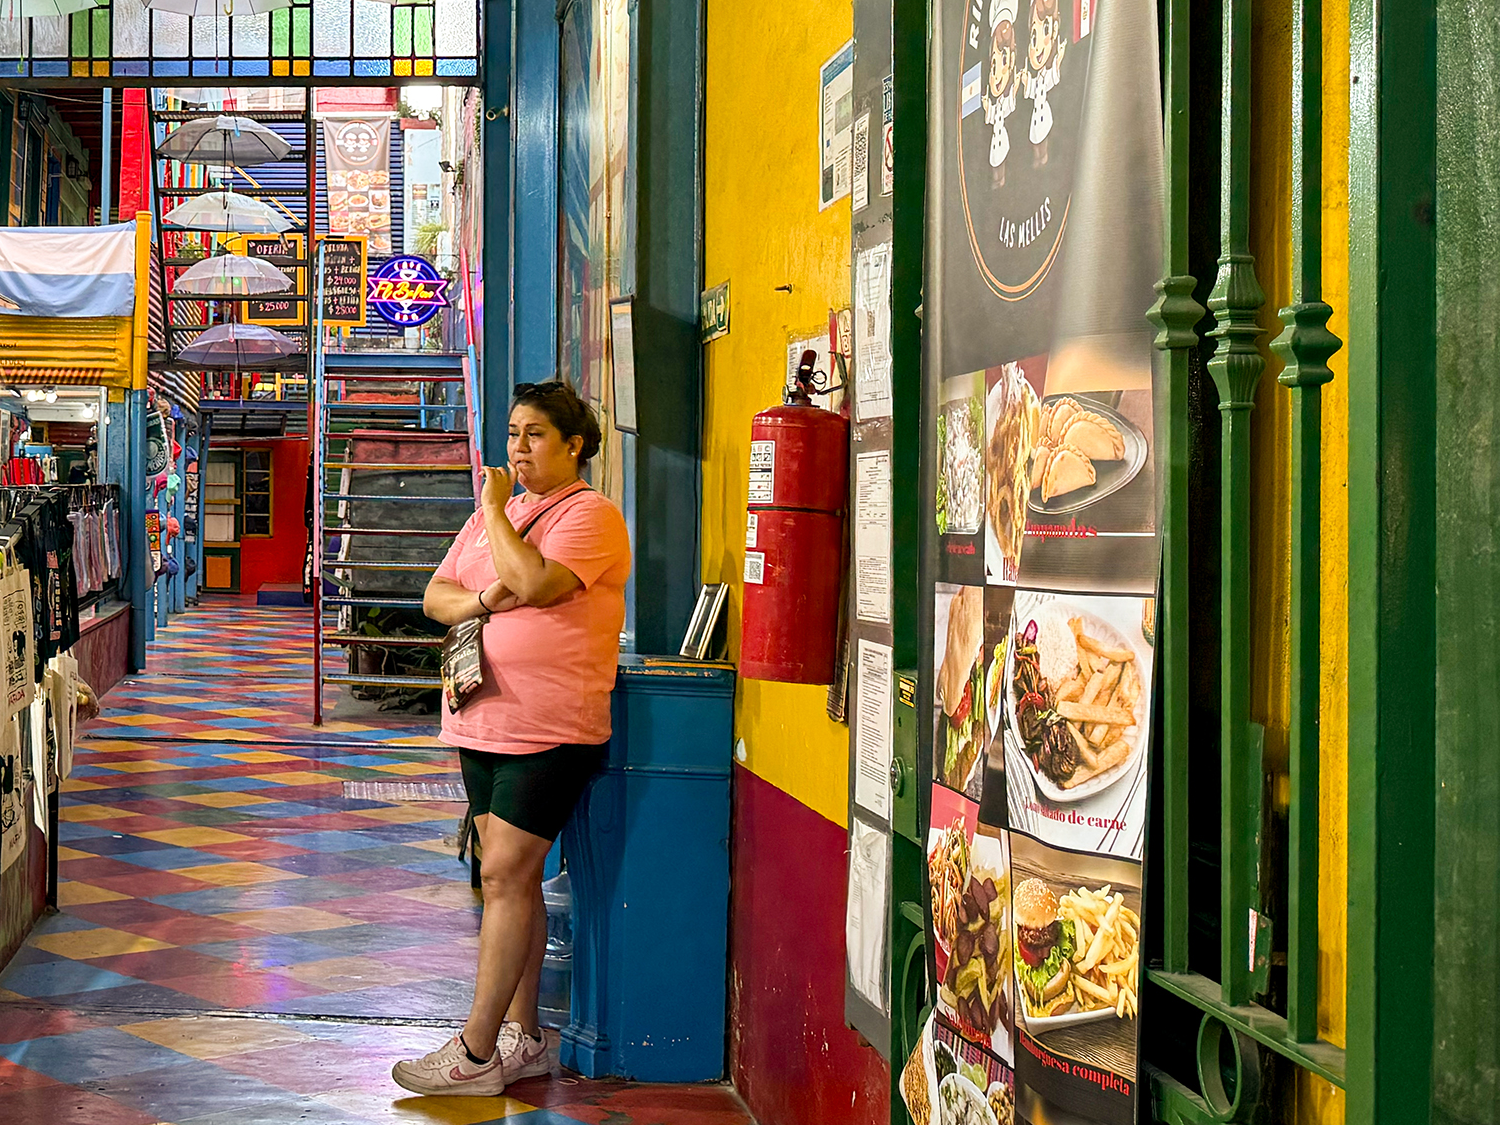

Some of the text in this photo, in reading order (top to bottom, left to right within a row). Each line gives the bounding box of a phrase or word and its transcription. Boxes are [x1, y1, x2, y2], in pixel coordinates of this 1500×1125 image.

[999, 196, 1051, 248] LAS MELLIS
[1067, 809, 1085, 825] de
[1087, 816, 1127, 832] carne
[1019, 1030, 1130, 1097] Hamburguesa completa
